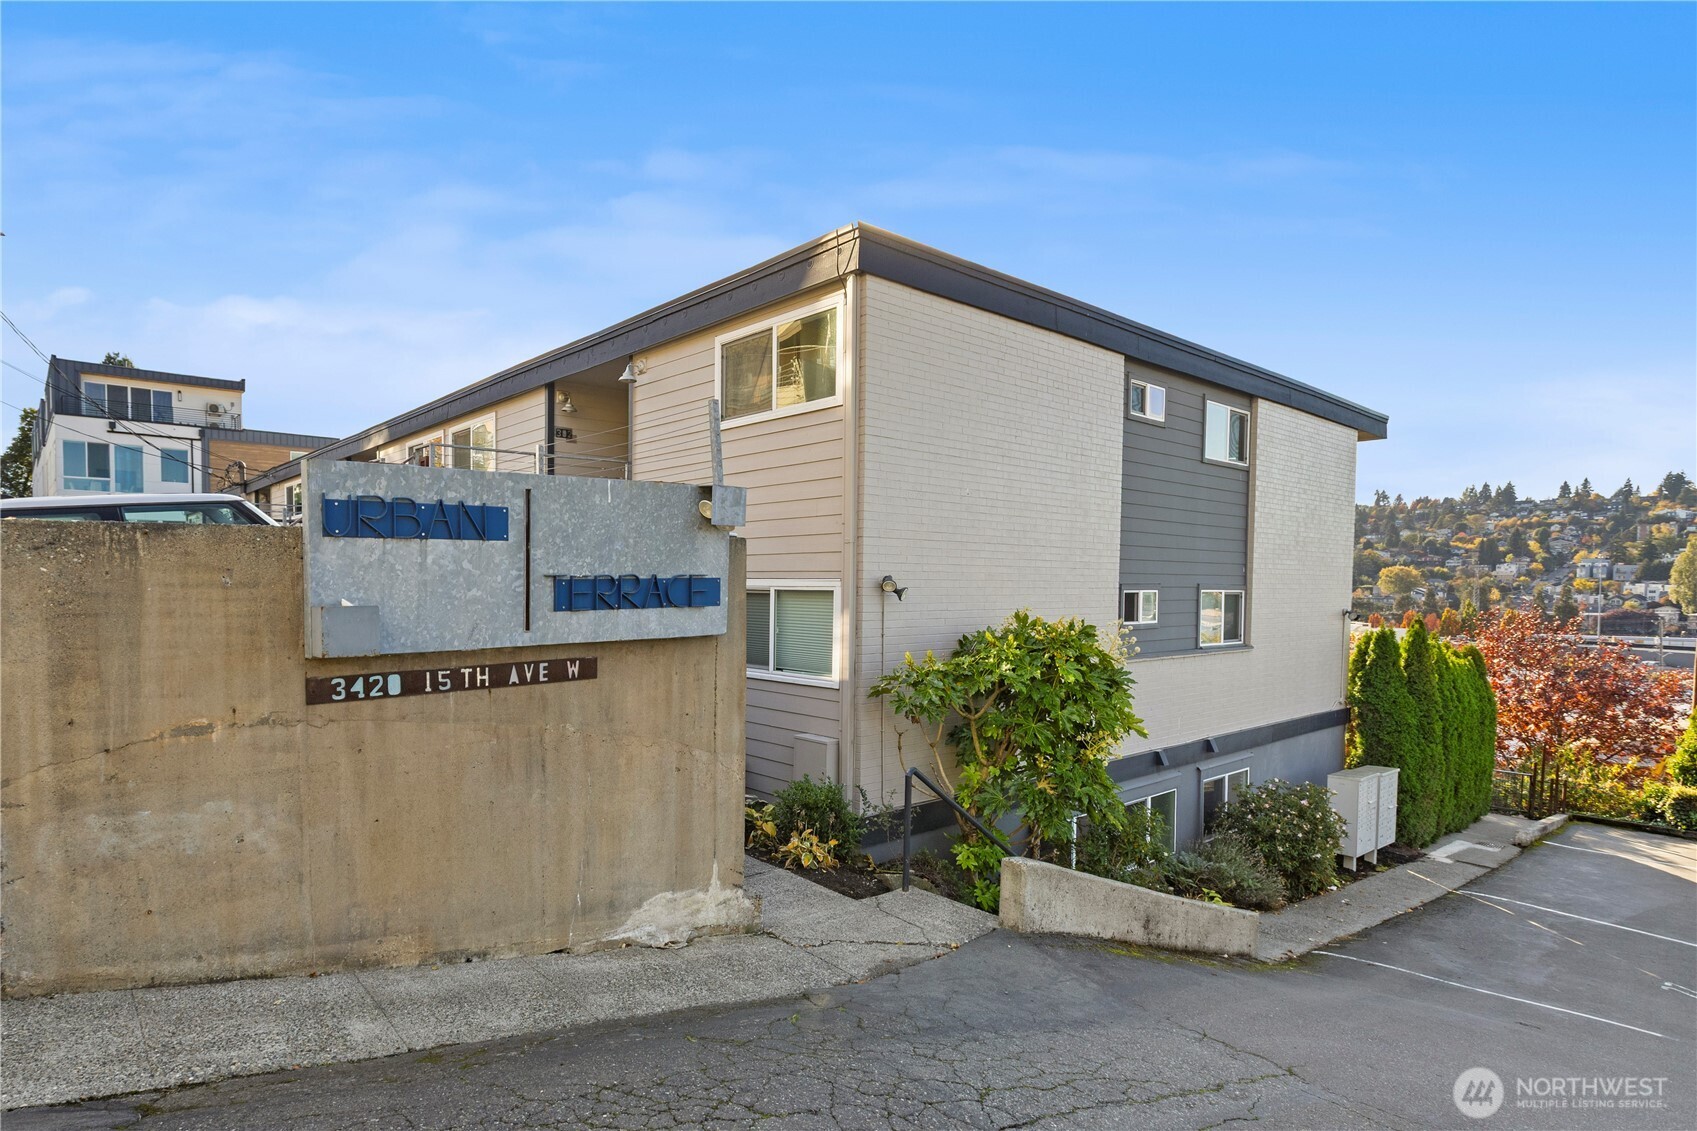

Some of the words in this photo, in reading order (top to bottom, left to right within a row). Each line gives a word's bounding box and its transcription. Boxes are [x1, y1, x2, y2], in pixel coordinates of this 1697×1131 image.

[322, 493, 487, 541] URBAN
[544, 574, 709, 612] TERRACE
[331, 673, 401, 700] 3420
[425, 667, 489, 692] 15TH
[509, 662, 549, 685] AVE
[567, 660, 580, 679] W
